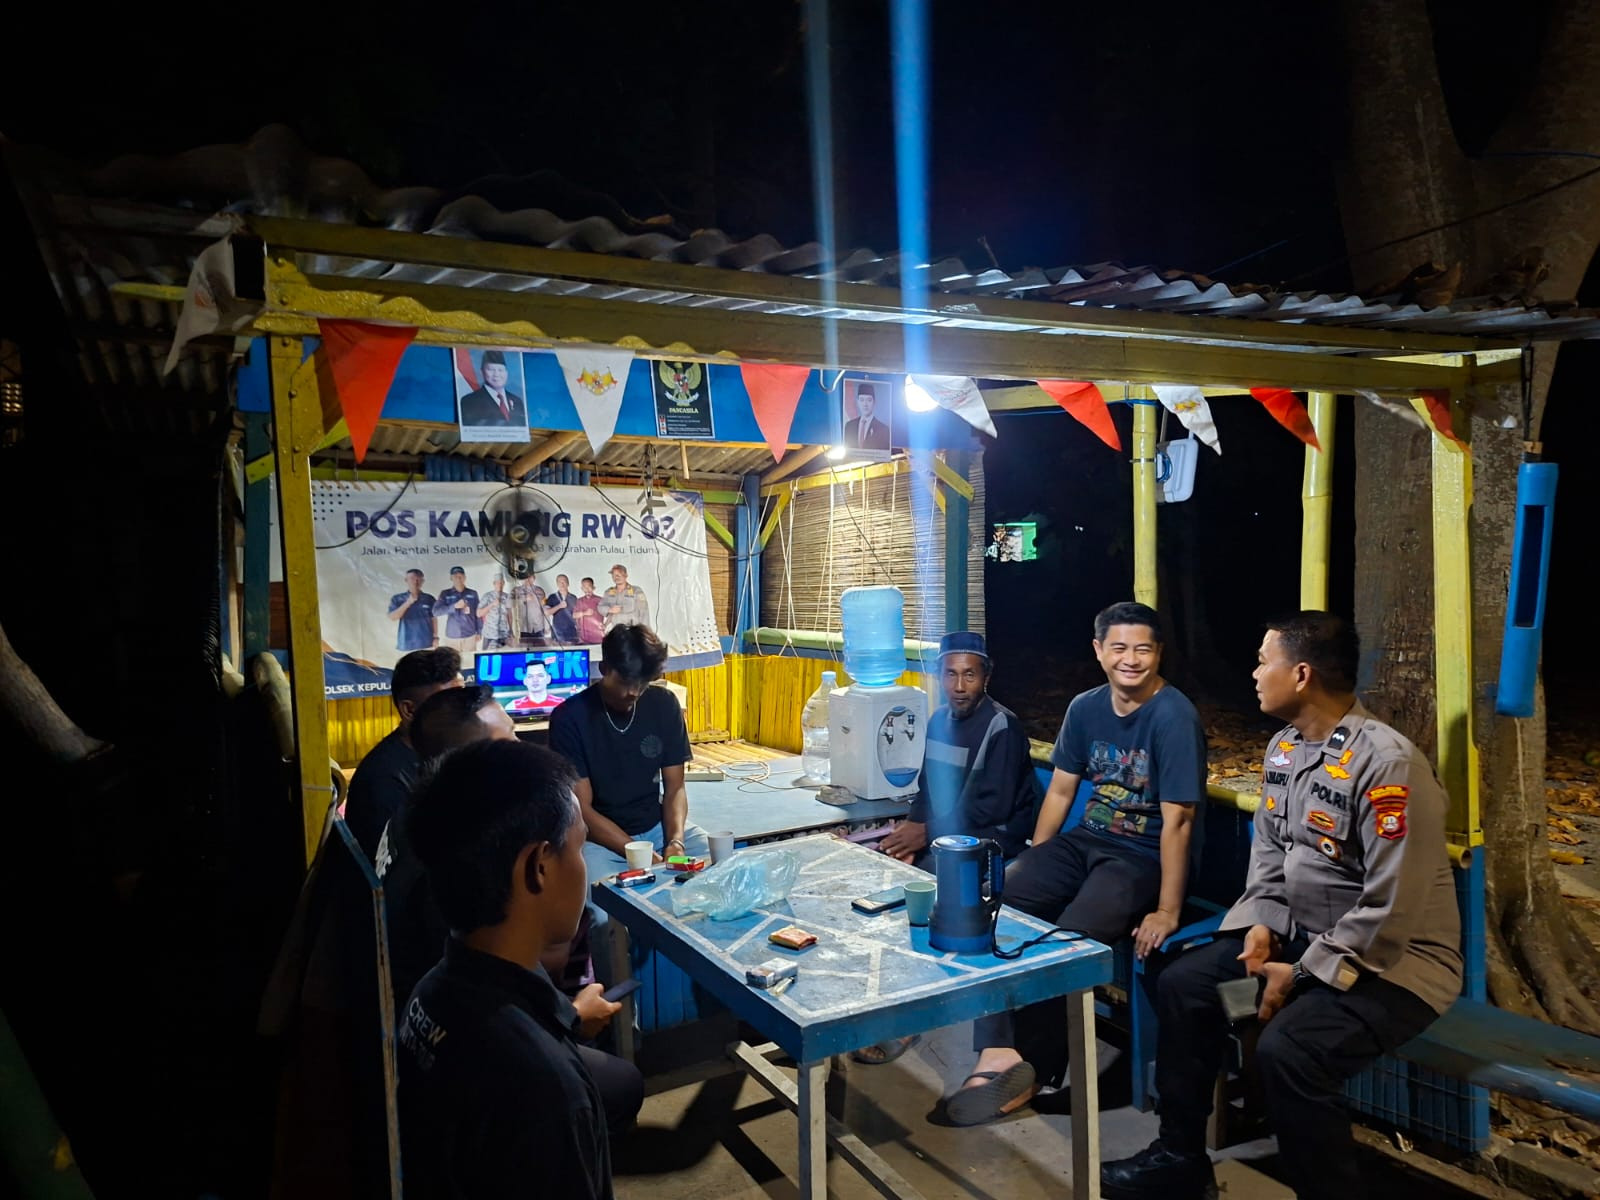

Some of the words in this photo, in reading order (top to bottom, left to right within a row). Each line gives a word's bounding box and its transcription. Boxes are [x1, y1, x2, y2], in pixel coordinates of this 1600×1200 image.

[346, 510, 417, 538] POS
[429, 510, 571, 538] KAMLNG
[640, 514, 676, 540] 03
[433, 544, 473, 554] Selatan
[600, 544, 625, 554] Pulau
[629, 545, 660, 554] Tidun
[324, 685, 355, 695] OLSEK
[357, 681, 392, 692] KEPUL
[1311, 781, 1347, 811] POLRI
[409, 997, 448, 1047] CREW
